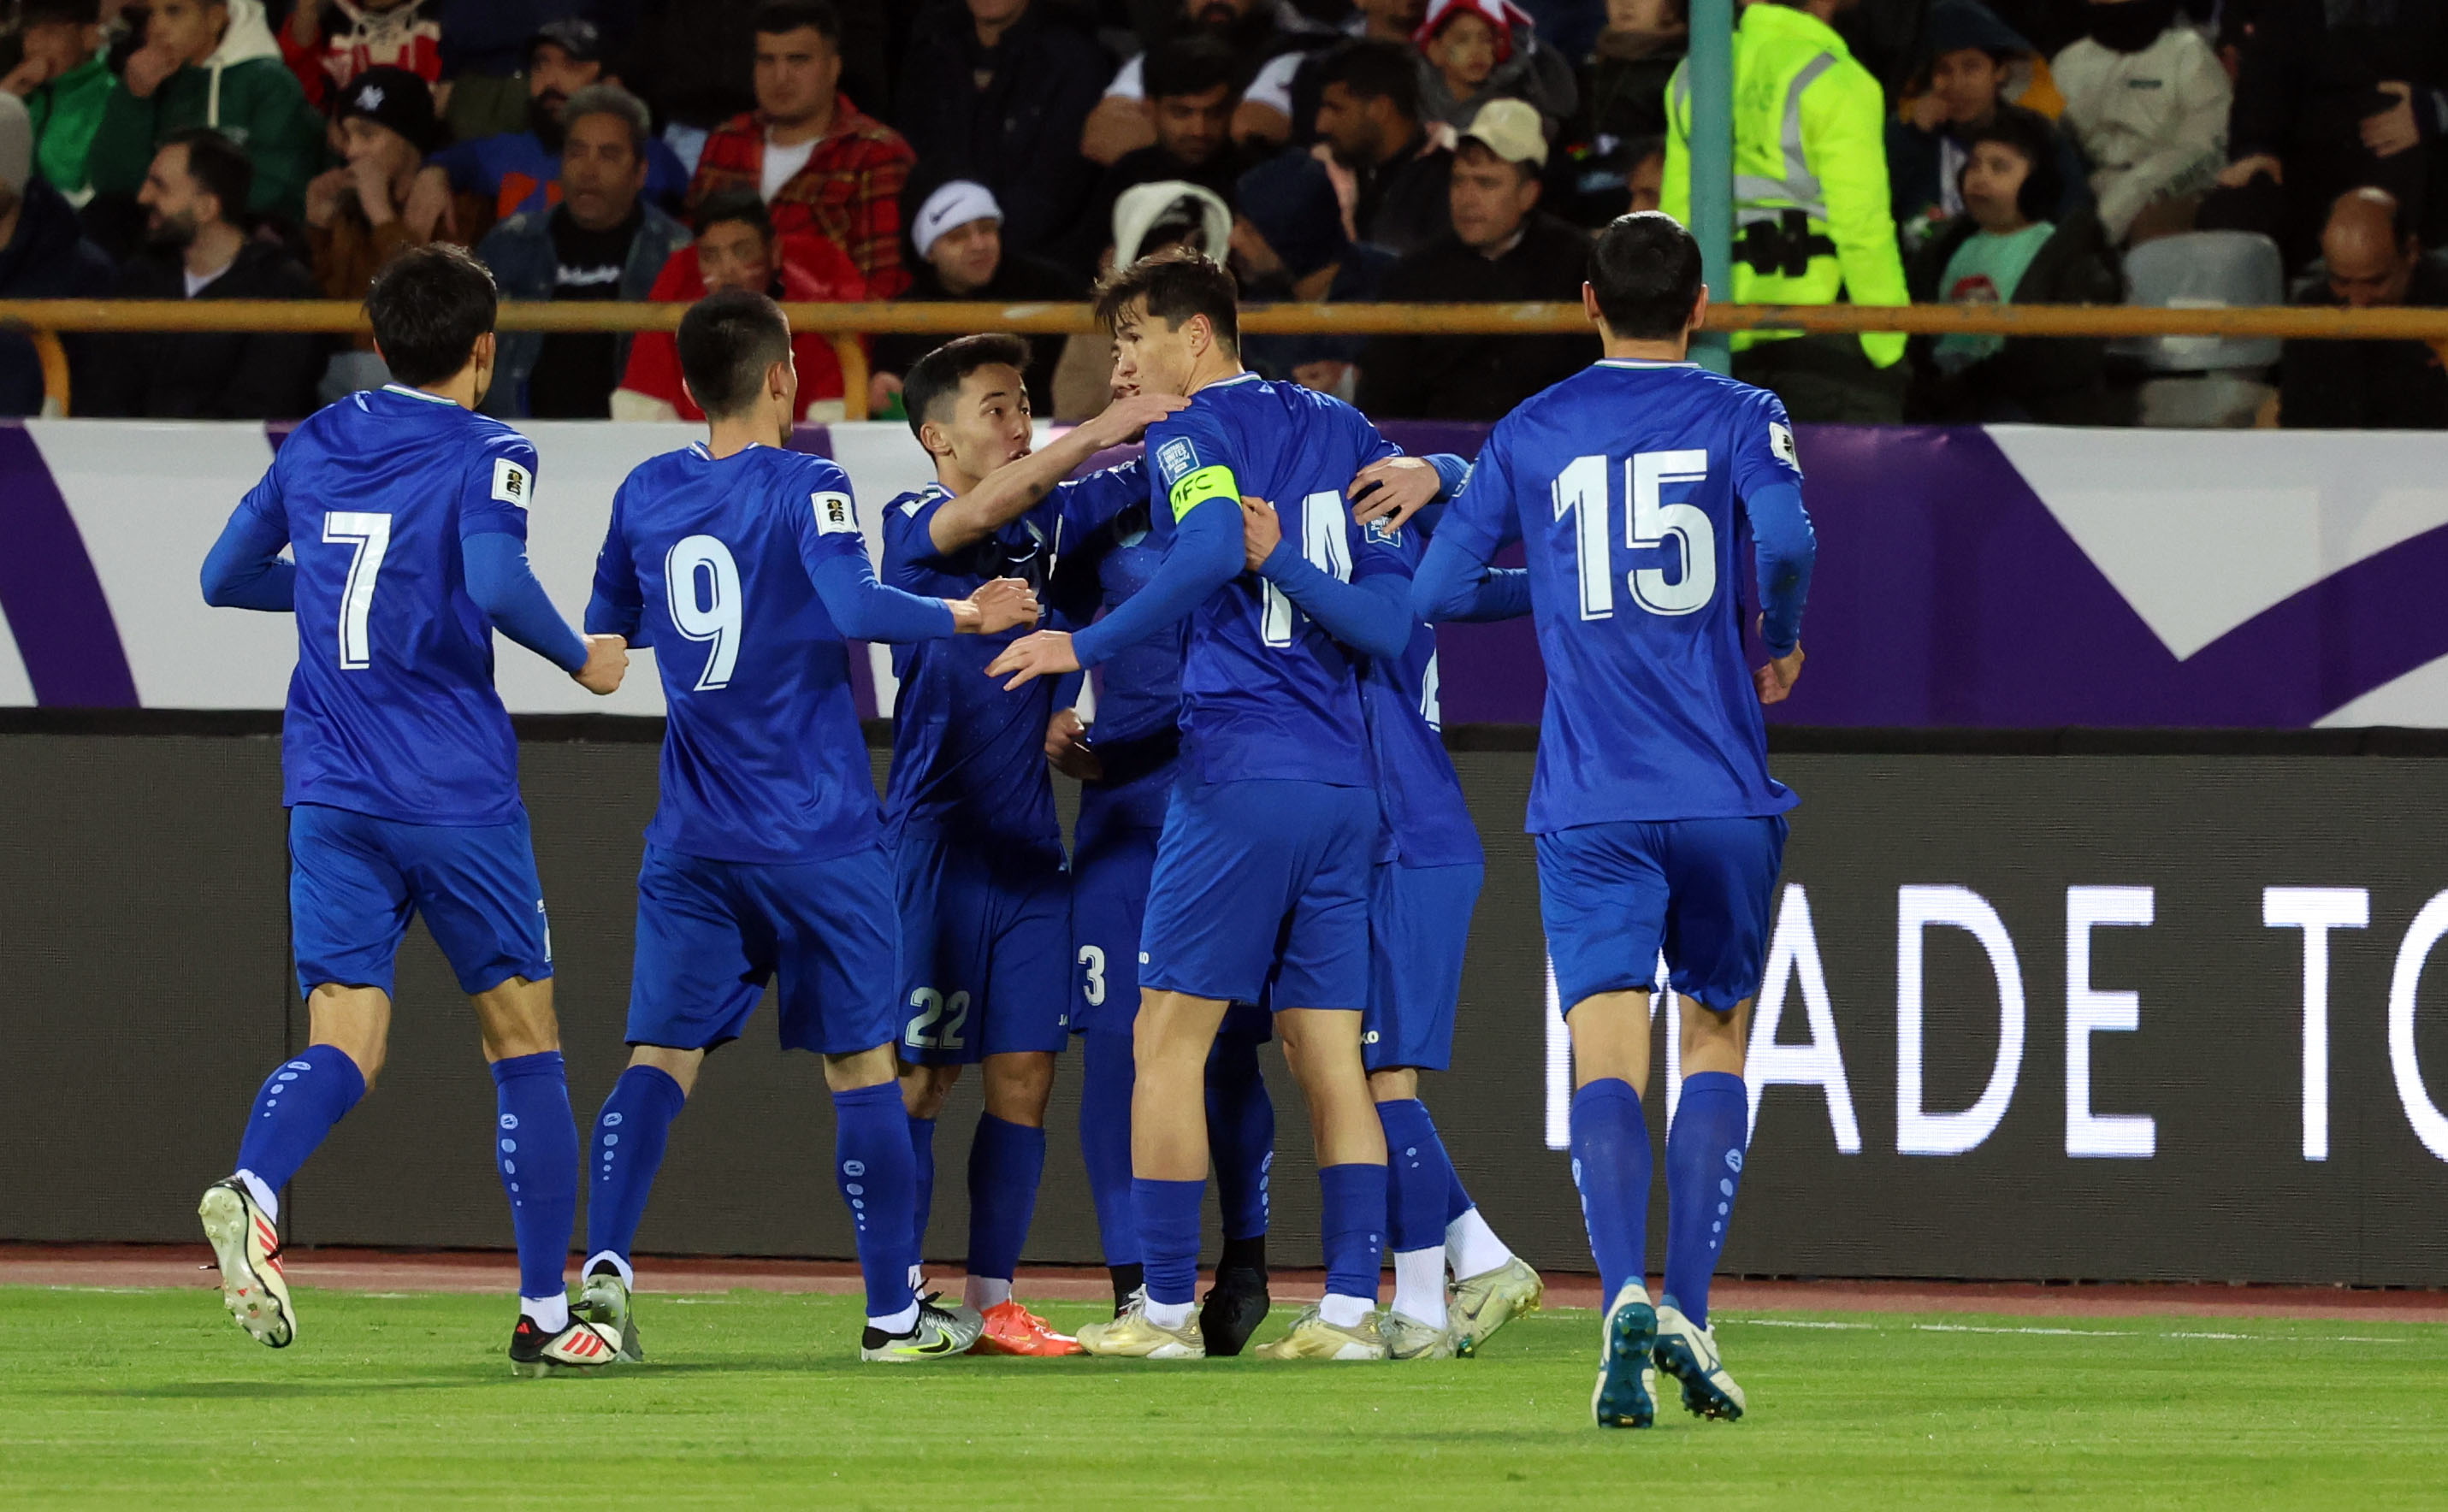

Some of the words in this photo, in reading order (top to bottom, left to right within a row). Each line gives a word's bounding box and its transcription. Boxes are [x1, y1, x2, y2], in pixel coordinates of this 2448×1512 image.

[1174, 473, 1214, 512] AFC
[1551, 449, 1717, 621] 15
[322, 511, 392, 670] 7
[665, 535, 742, 692] 9
[905, 986, 970, 1049] 22
[1078, 944, 1105, 1007] 3
